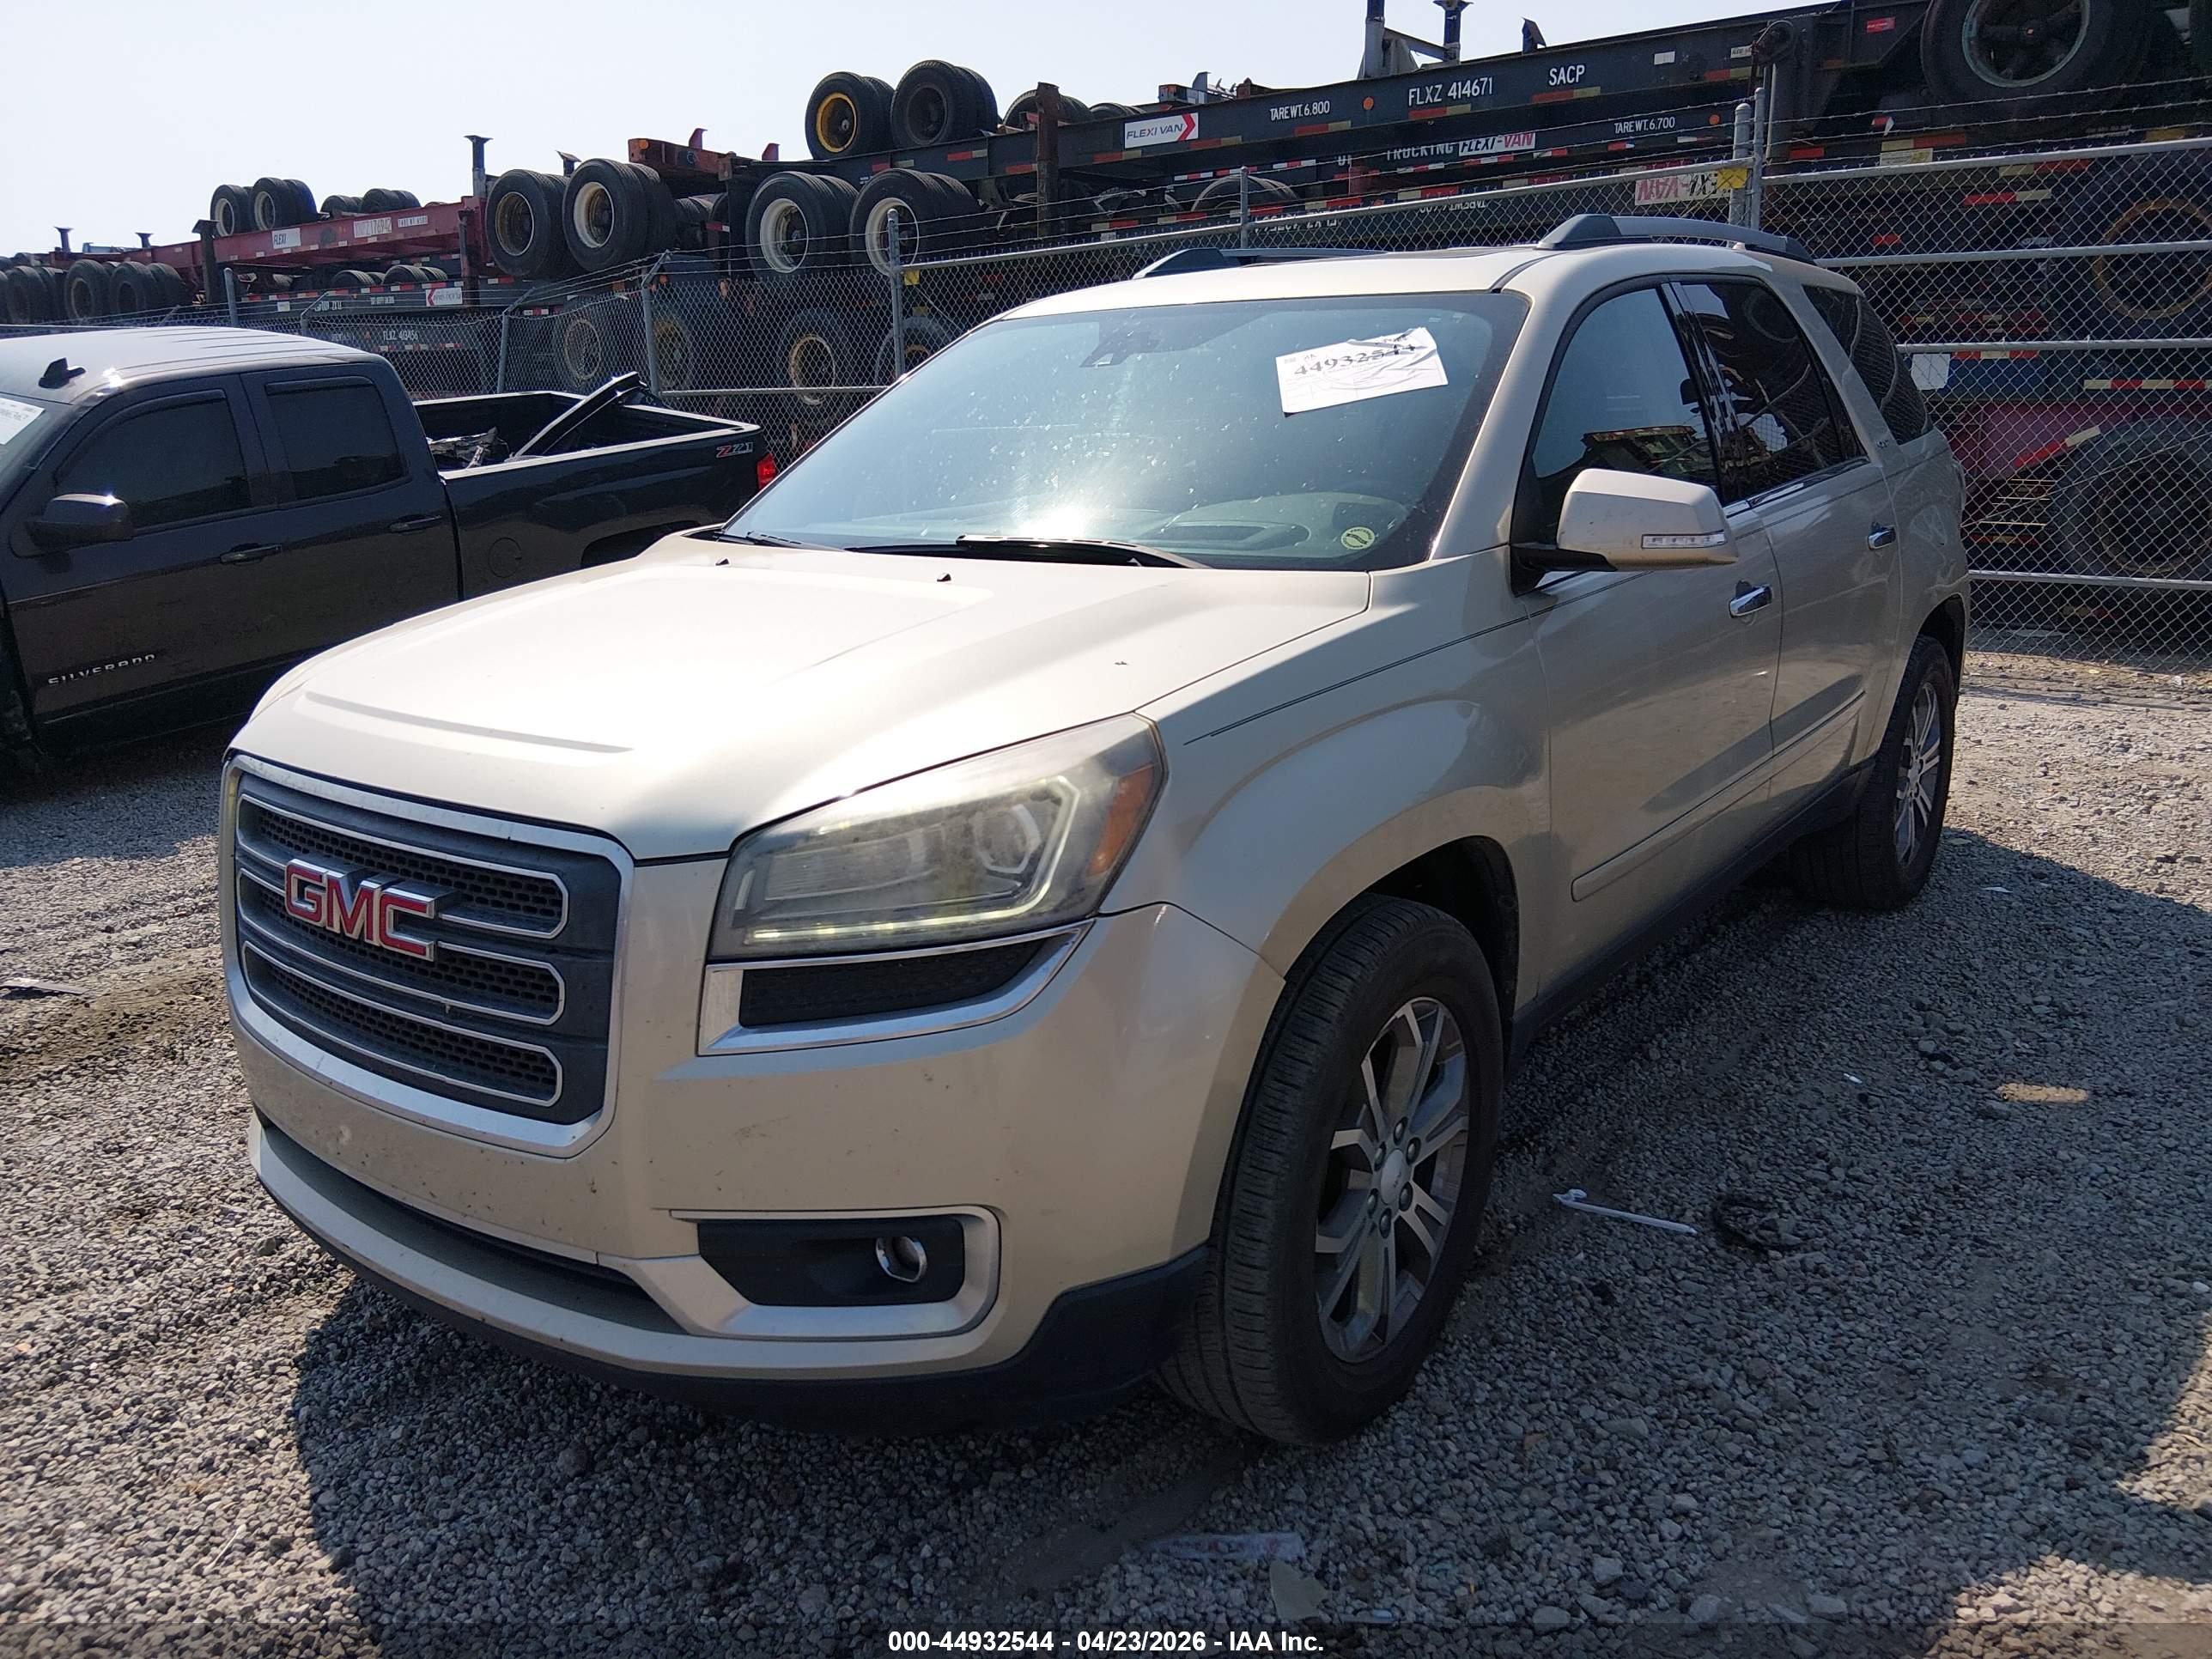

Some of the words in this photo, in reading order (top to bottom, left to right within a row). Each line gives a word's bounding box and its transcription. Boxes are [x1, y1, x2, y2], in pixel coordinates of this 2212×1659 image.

[1548, 64, 1586, 87] SACP
[1408, 83, 1443, 106] FLXZ
[1448, 77, 1493, 100] 414671
[1127, 127, 1158, 139] FLEXI
[1160, 124, 1183, 135] VAN
[48, 653, 155, 685] SILVERADO
[285, 858, 436, 963] GMC
